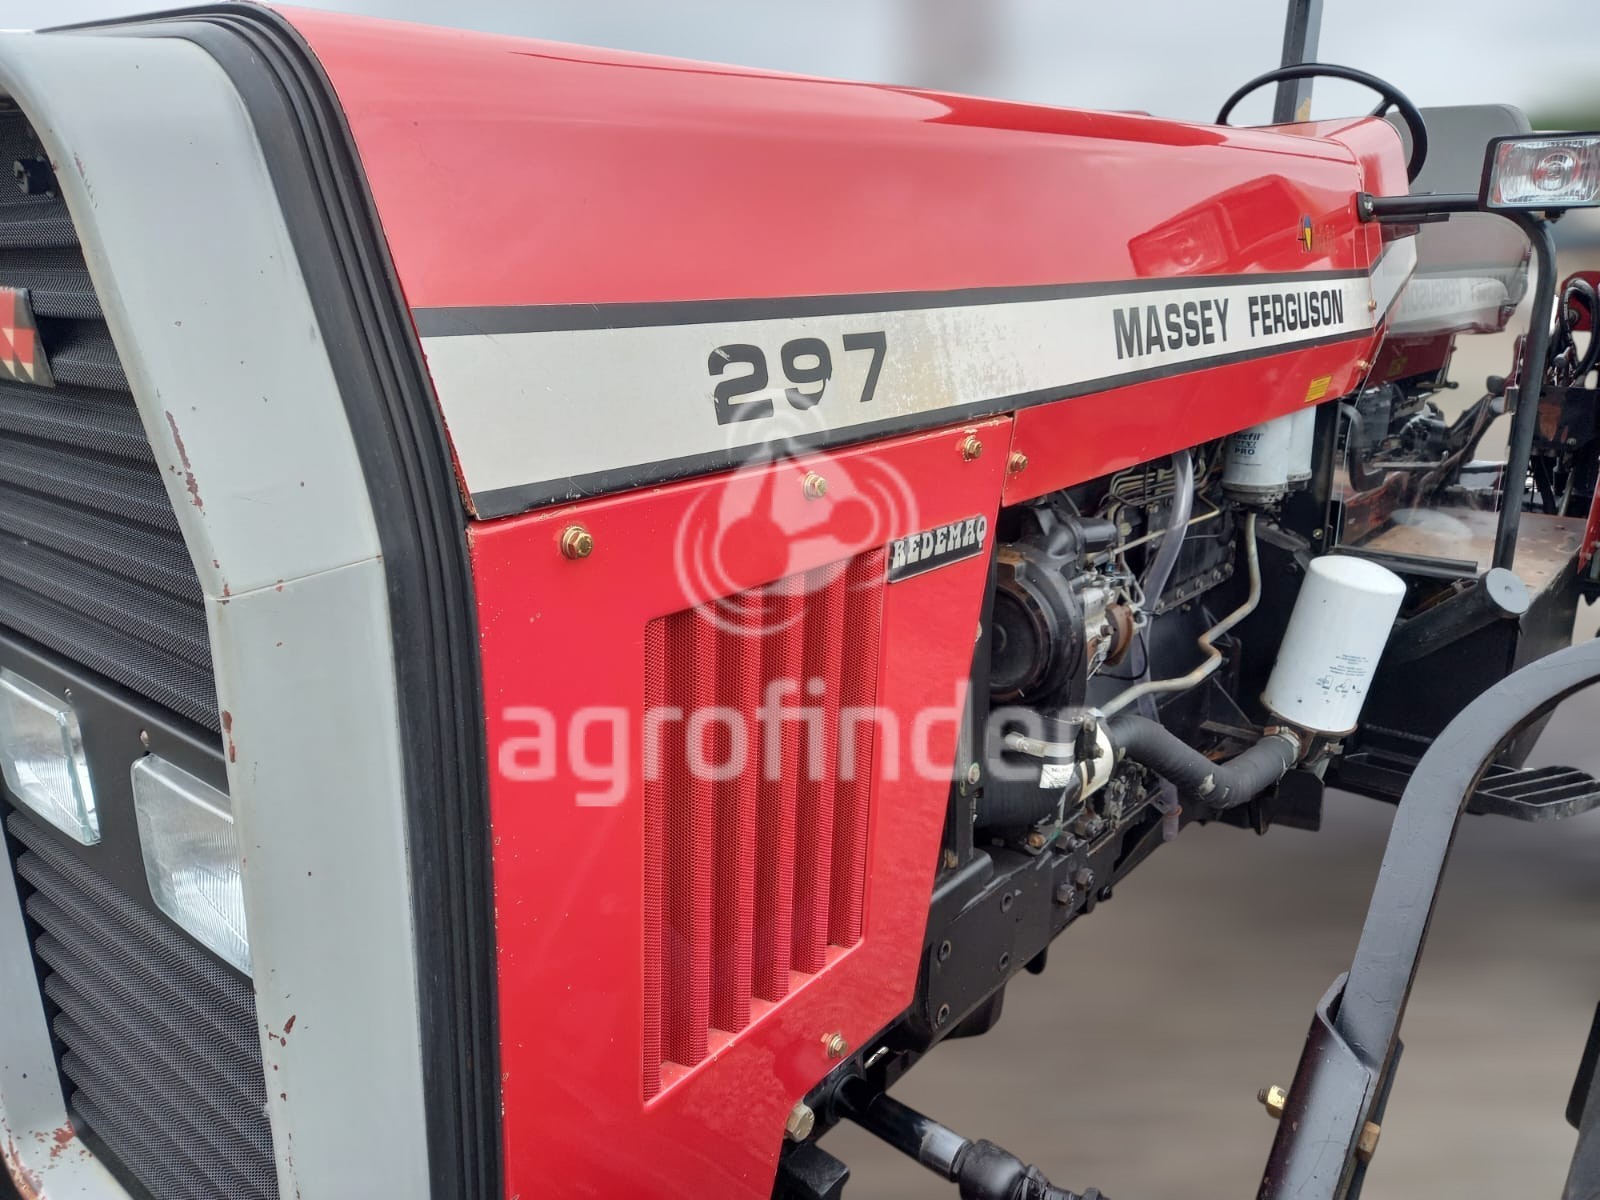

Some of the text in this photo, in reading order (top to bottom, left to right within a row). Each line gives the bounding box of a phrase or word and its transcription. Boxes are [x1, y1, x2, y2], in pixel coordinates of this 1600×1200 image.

[1113, 298, 1229, 360] MASSEY
[1248, 288, 1344, 338] FERGUSON
[708, 331, 887, 426] 297
[891, 514, 988, 569] REDEMAQ
